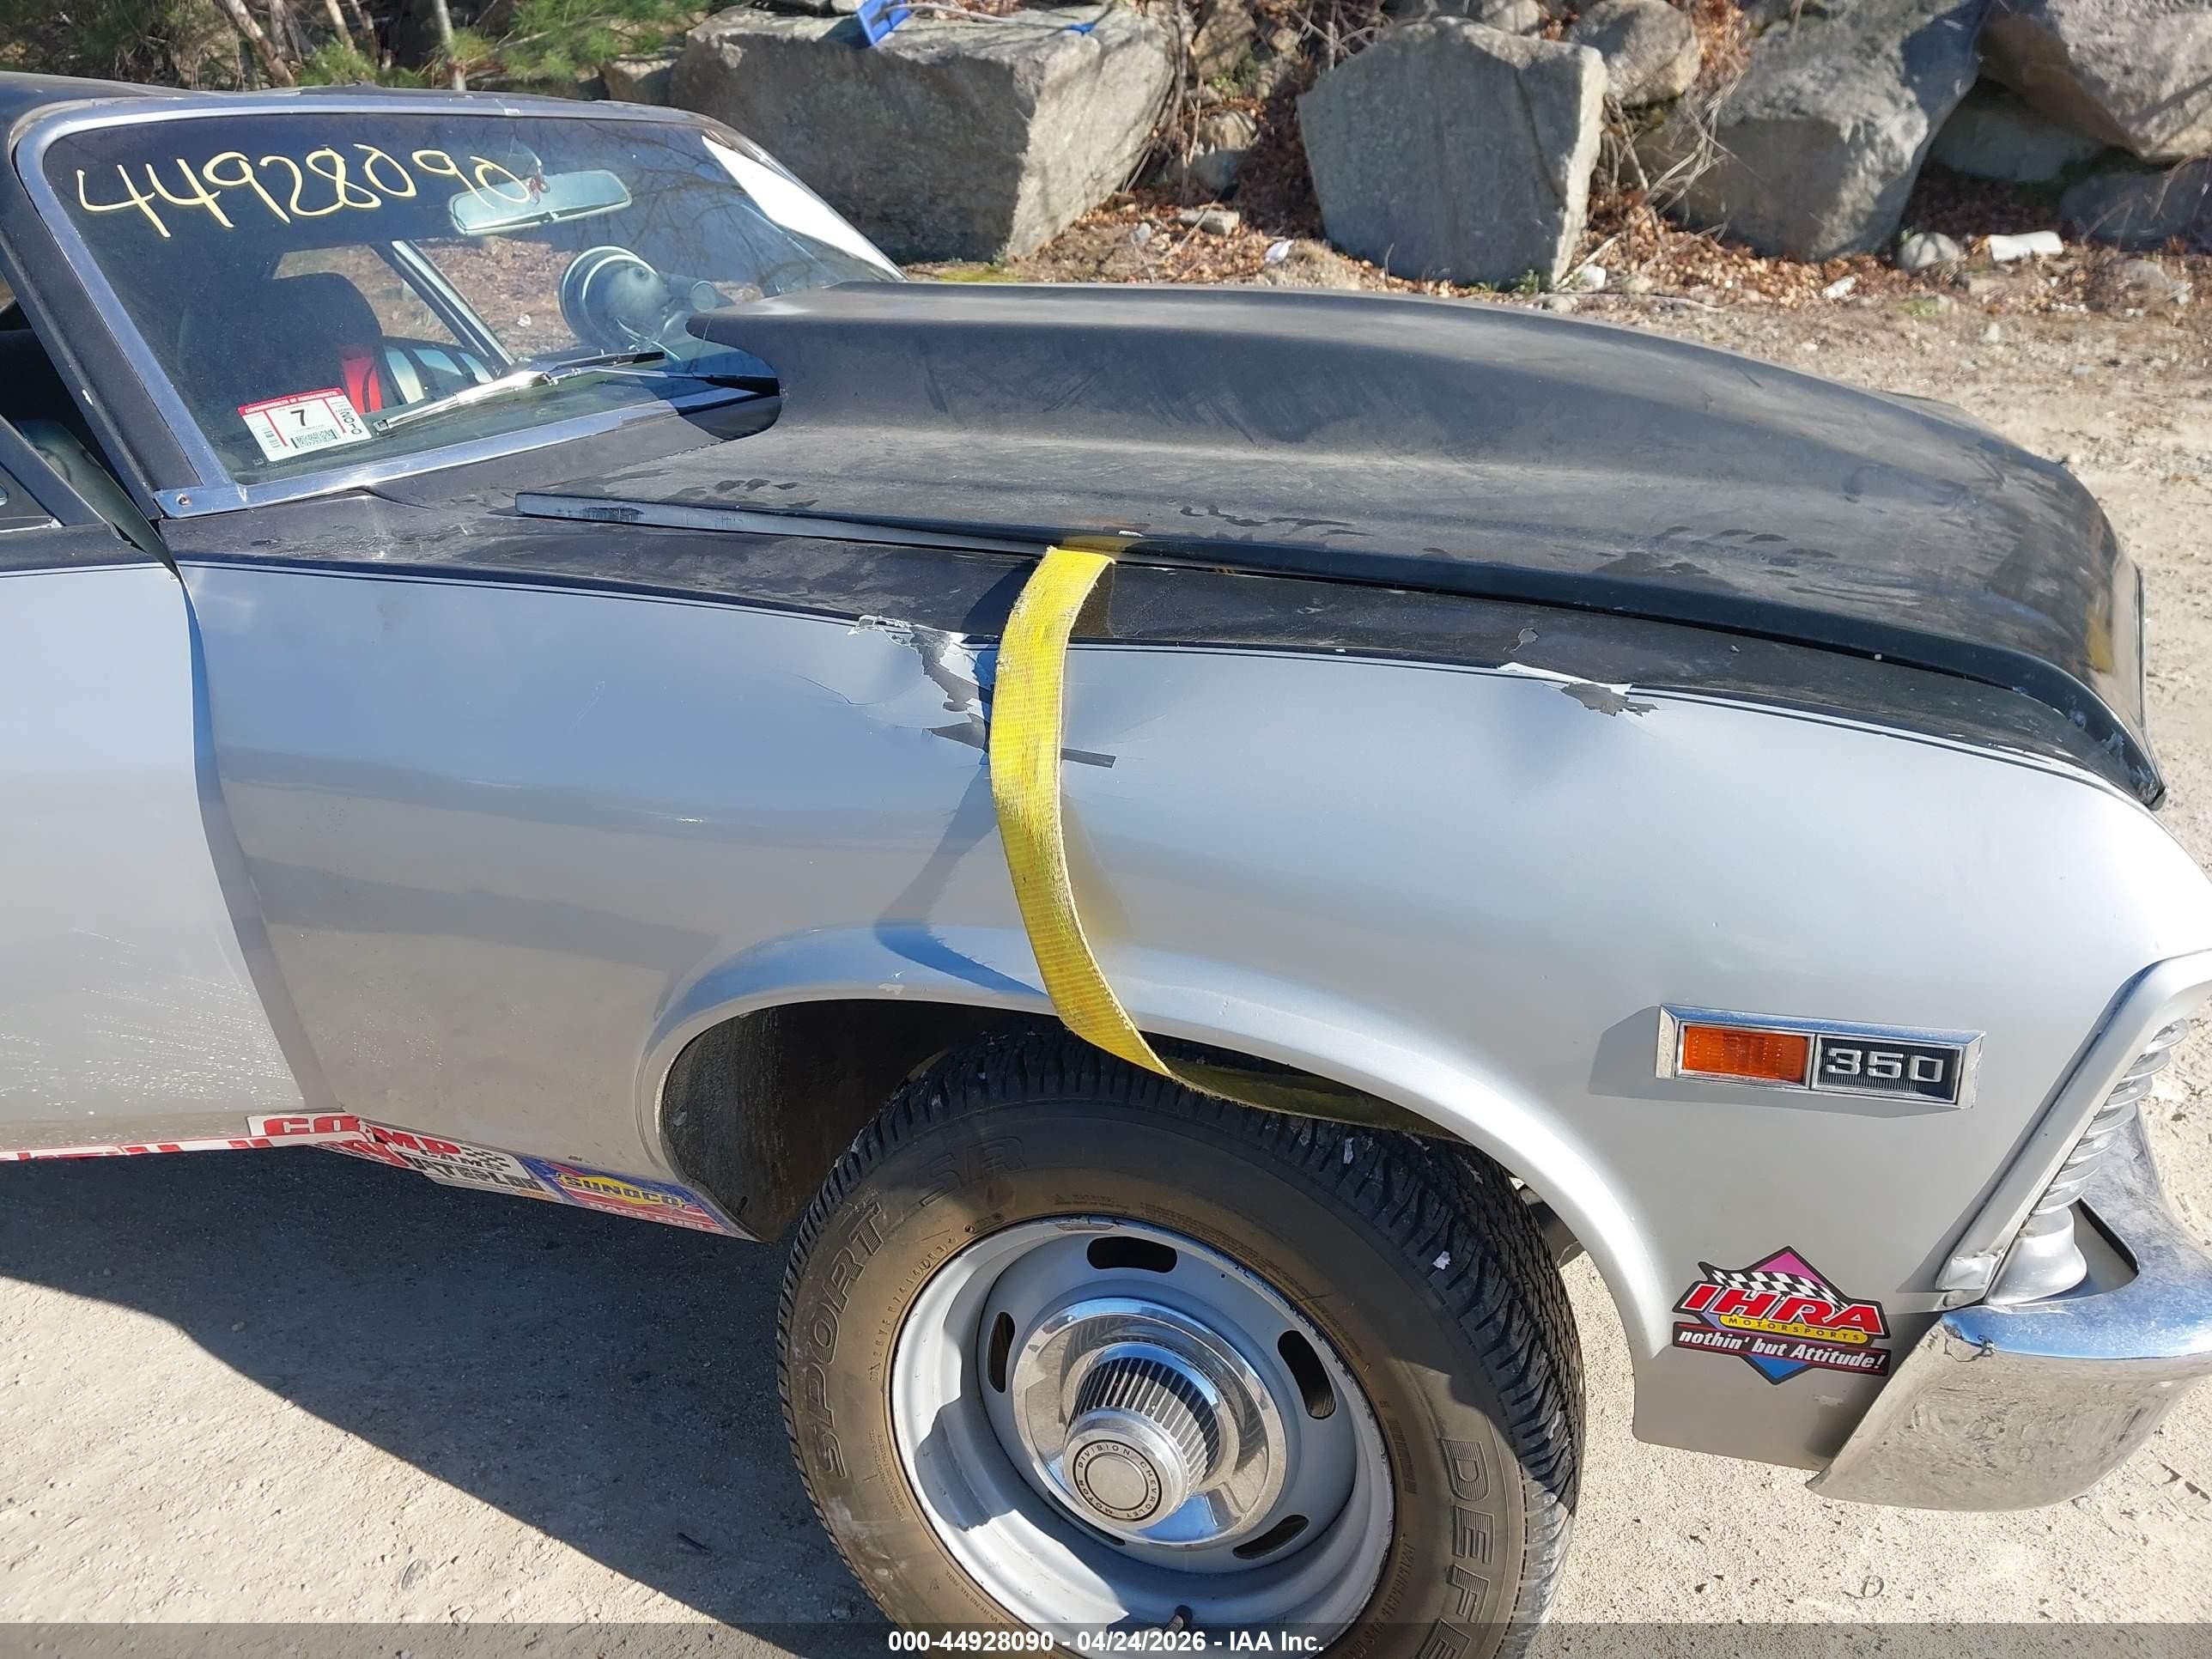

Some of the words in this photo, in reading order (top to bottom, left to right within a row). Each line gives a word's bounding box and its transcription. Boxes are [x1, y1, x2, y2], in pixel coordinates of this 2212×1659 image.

[76, 143, 531, 238] 44928090
[290, 409, 307, 427] 7
[1825, 1047, 1944, 1084] 350
[564, 1176, 684, 1207] SUNOCO
[1680, 1283, 1886, 1335] IHRA
[805, 1200, 884, 1479] SPORT
[1728, 1317, 1860, 1341] MOTORSPORTS
[1678, 1331, 1750, 1350] nothin'
[1752, 1338, 1786, 1358] but
[1789, 1344, 1887, 1370] Attitude!
[1078, 1444, 1130, 1469] DIVISION
[1079, 1480, 1114, 1514] MOTOR
[1127, 1462, 1158, 1518] CHEVROLET
